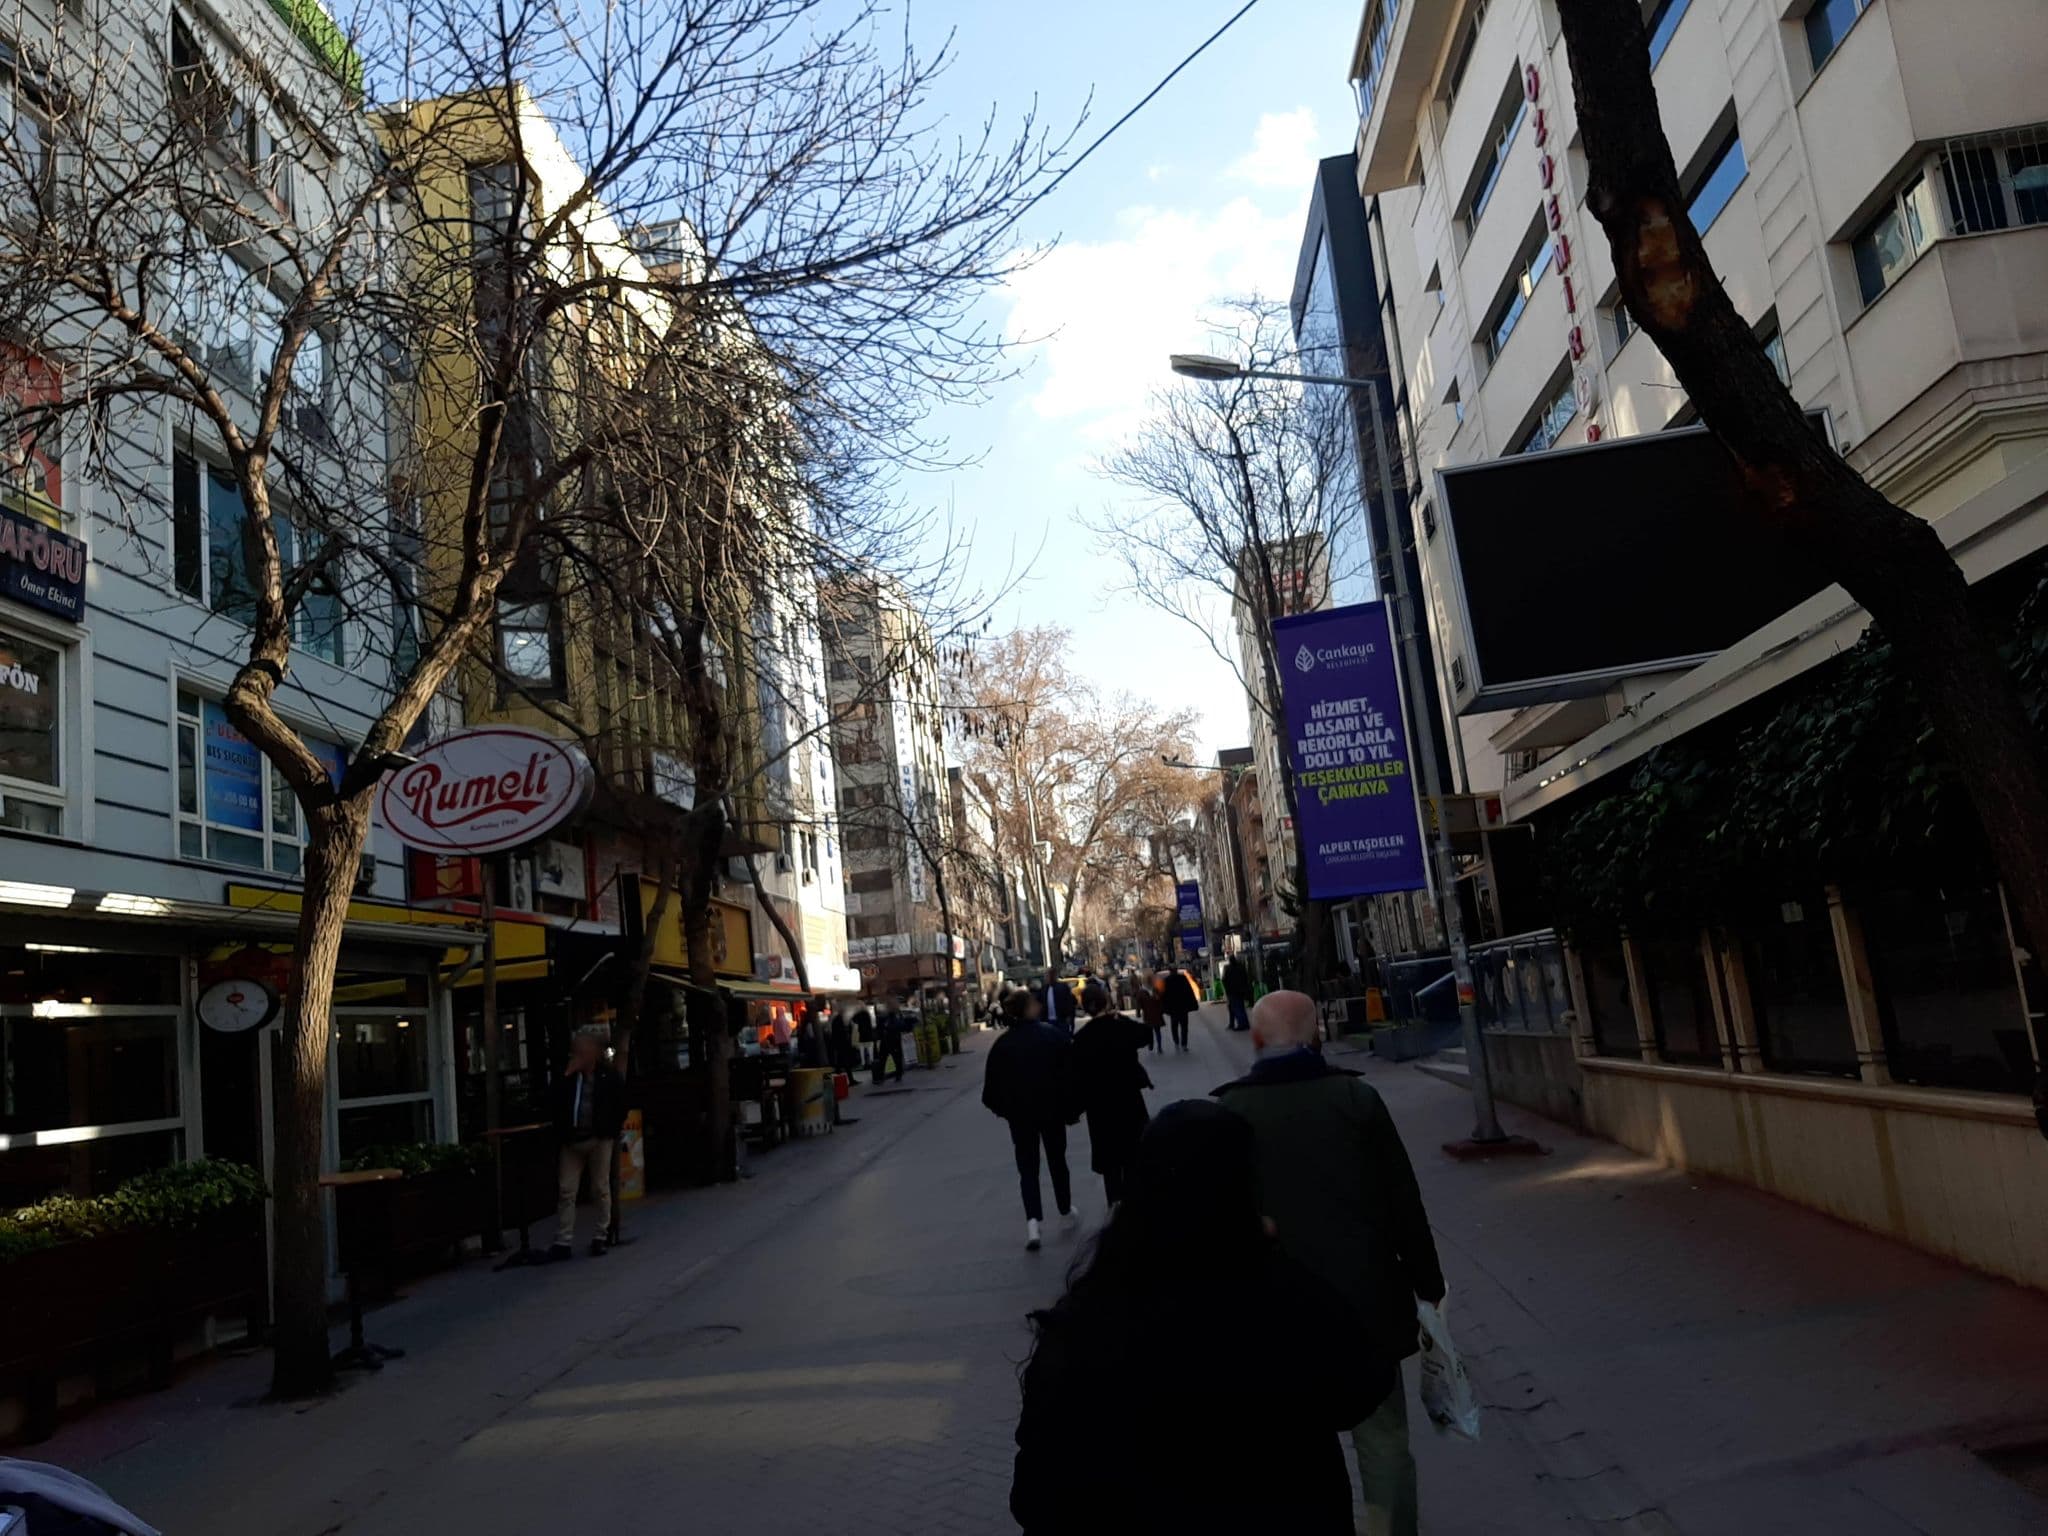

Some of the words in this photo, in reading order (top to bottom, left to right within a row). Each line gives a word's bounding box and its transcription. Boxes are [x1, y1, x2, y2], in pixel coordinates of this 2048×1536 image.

[0, 513, 82, 584] AFÖRÜ
[1311, 697, 1372, 719] HİZMET,
[1363, 712, 1384, 729] VE
[1297, 728, 1395, 755] REKORLARLA
[1304, 750, 1344, 769] DOLU
[1347, 747, 1366, 763] 10
[1368, 743, 1392, 760] YIL
[403, 752, 551, 828] Rumeli
[1318, 779, 1389, 806] ÇANKAYA
[1319, 841, 1351, 855] ALPER
[1352, 835, 1404, 852] TAŞDELEN
